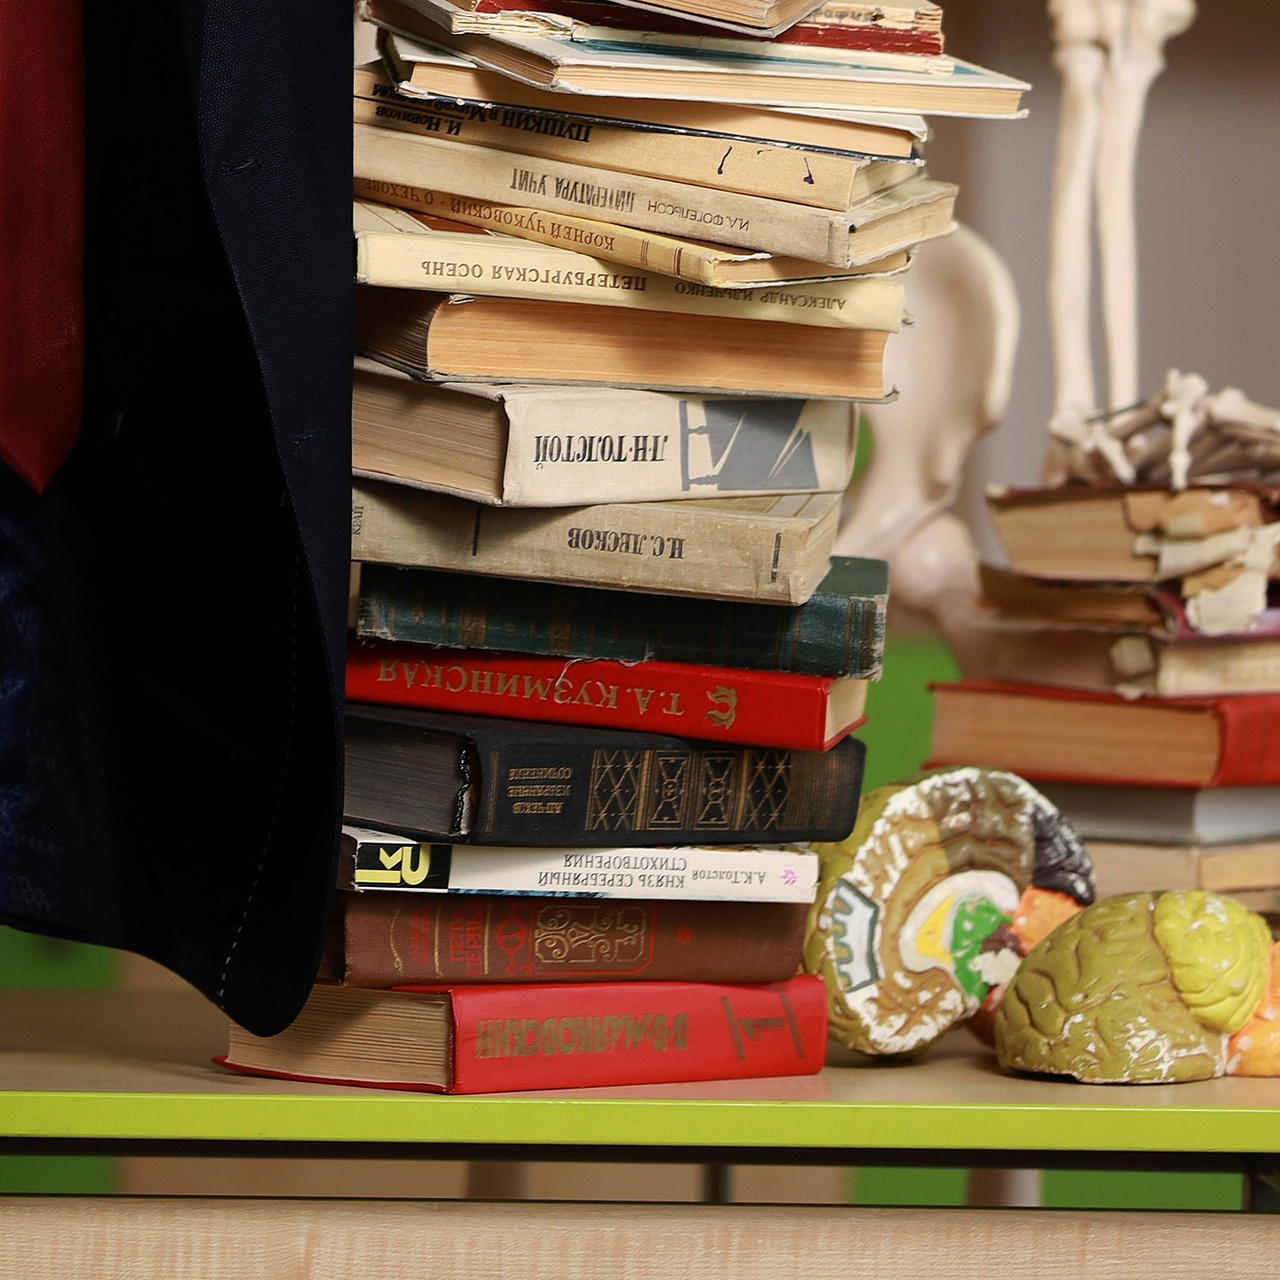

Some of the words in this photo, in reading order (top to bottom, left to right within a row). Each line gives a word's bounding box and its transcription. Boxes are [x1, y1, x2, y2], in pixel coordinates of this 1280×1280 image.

[501, 110, 592, 143] ПУШКИН
[363, 178, 420, 201] ЧЕХОВЕ
[509, 168, 547, 195] УЧИТ
[424, 190, 434, 205] О
[554, 177, 635, 213] ЛИТЕРАТУРА
[448, 198, 545, 235] ЧУКОВСКИЙ
[647, 200, 724, 225] ФОГЕЛЬСОН
[550, 223, 615, 251] КОРНЕЙ
[420, 260, 483, 279] ОСЕНЬ
[491, 265, 646, 291] ПЕТЕРБУРГСКАЯ
[674, 282, 752, 301] ИЛЬЧЕНКО
[760, 290, 846, 311] АЛЕКСАНДР
[567, 527, 647, 556] ЛЕСКОВ
[377, 658, 618, 709] КУЗМИНСКАЯ
[563, 853, 688, 871] СТИХОТВОРЕНИЯ
[538, 870, 634, 888] СЕРЕБРЯНЫЙ
[638, 872, 685, 889] КНЯЗЬ
